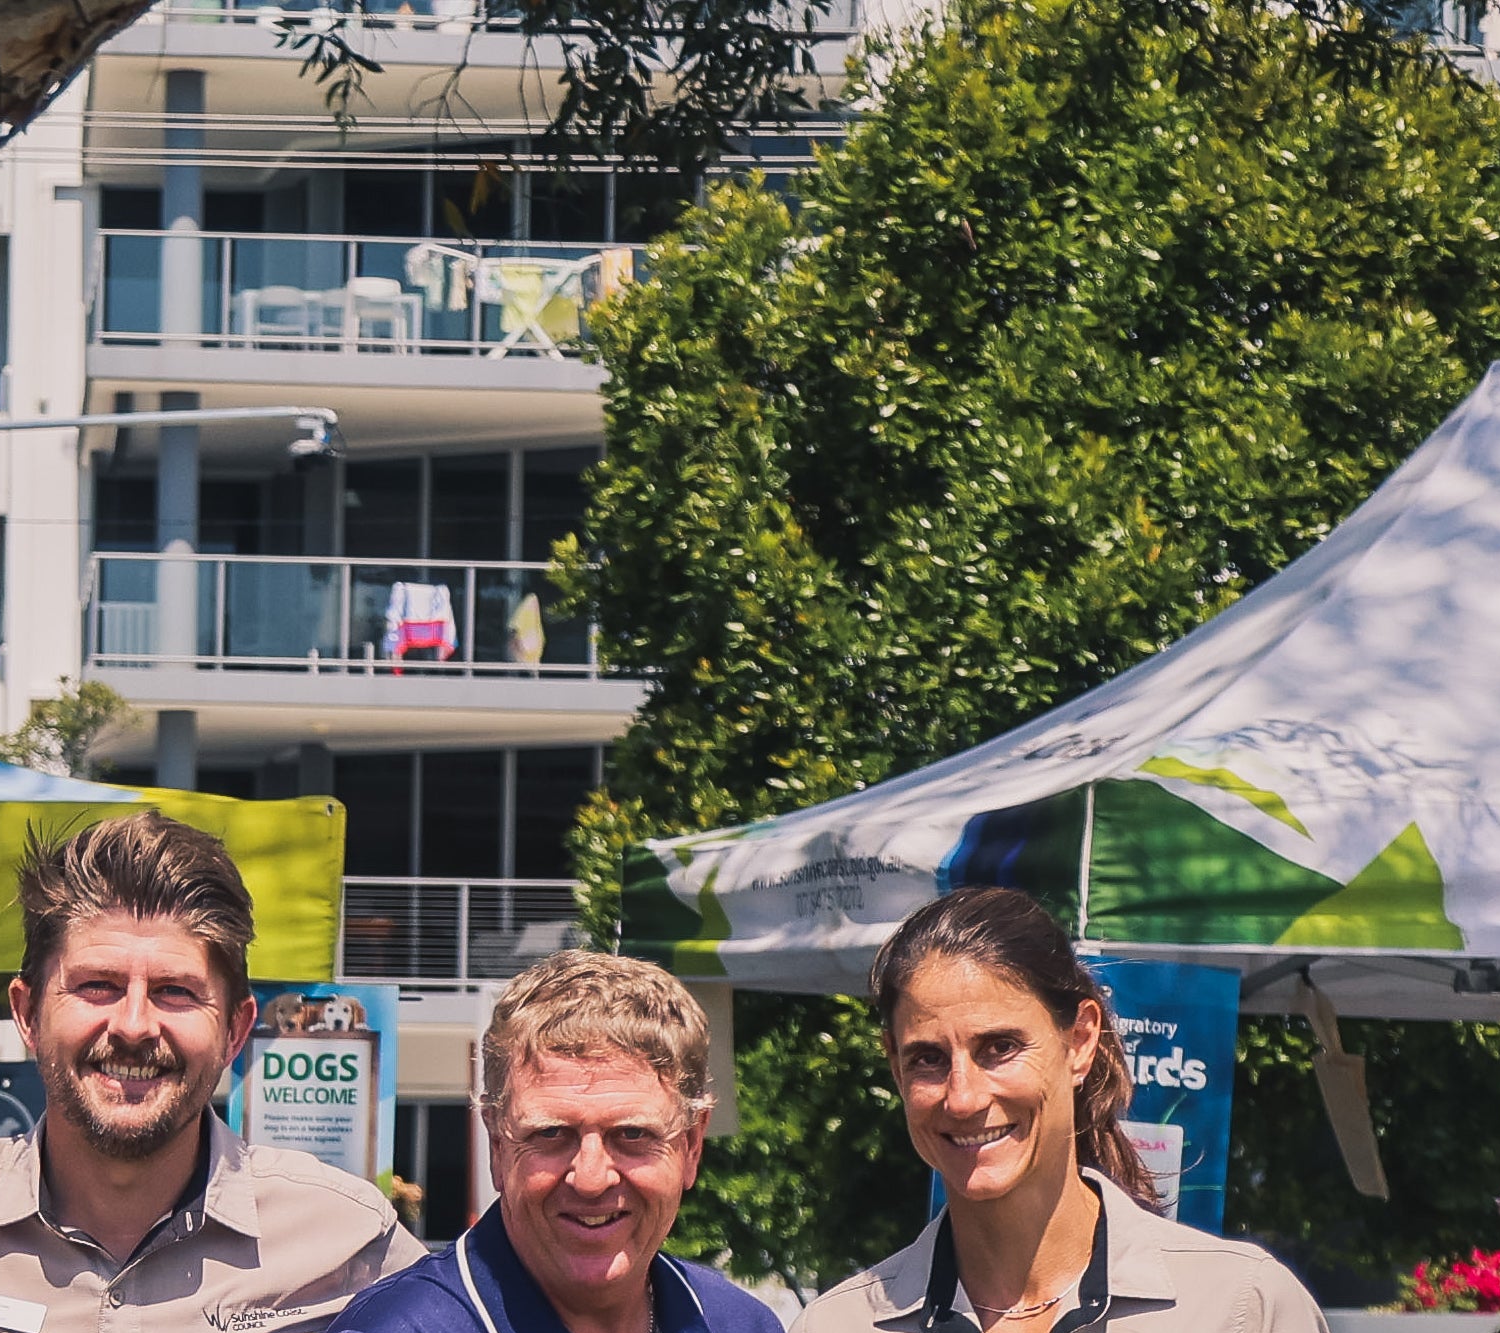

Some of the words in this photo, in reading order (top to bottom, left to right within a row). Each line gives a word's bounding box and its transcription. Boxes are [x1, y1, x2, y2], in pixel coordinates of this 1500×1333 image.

[263, 1052, 359, 1082] DOGS
[263, 1086, 358, 1105] WELCOME
[231, 1309, 276, 1323] Sunshine
[232, 1321, 267, 1331] COUNCIL
